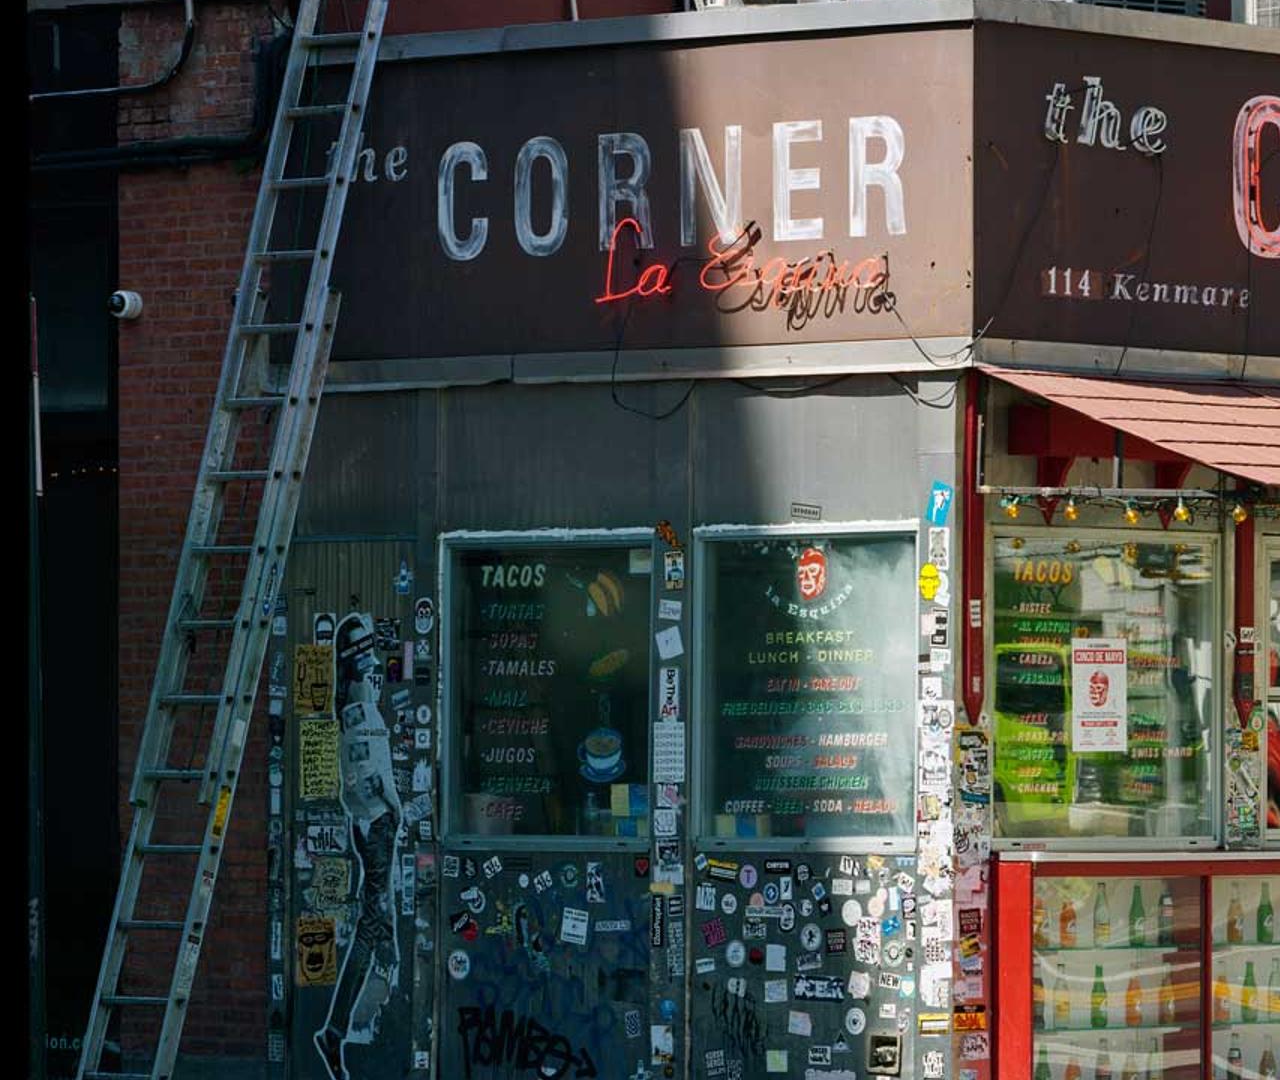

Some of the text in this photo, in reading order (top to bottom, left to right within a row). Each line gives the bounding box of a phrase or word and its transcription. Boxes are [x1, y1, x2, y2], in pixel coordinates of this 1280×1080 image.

[1044, 76, 1168, 155] the
[436, 115, 908, 262] CORNER
[1047, 266, 1249, 308] 114 Kenmare
[480, 563, 548, 589] TACOS
[1013, 558, 1073, 584] TACOS
[787, 583, 854, 621] Esquina
[766, 629, 855, 645] BREAKFAST
[749, 648, 875, 664] LUNCH DINNER
[487, 659, 556, 677] TAMALES
[818, 732, 889, 747] HAMBURGER
[485, 747, 536, 765] JUGOS
[724, 799, 765, 814] COFFEE
[813, 799, 844, 813] SODA
[879, 972, 900, 989] NEW
